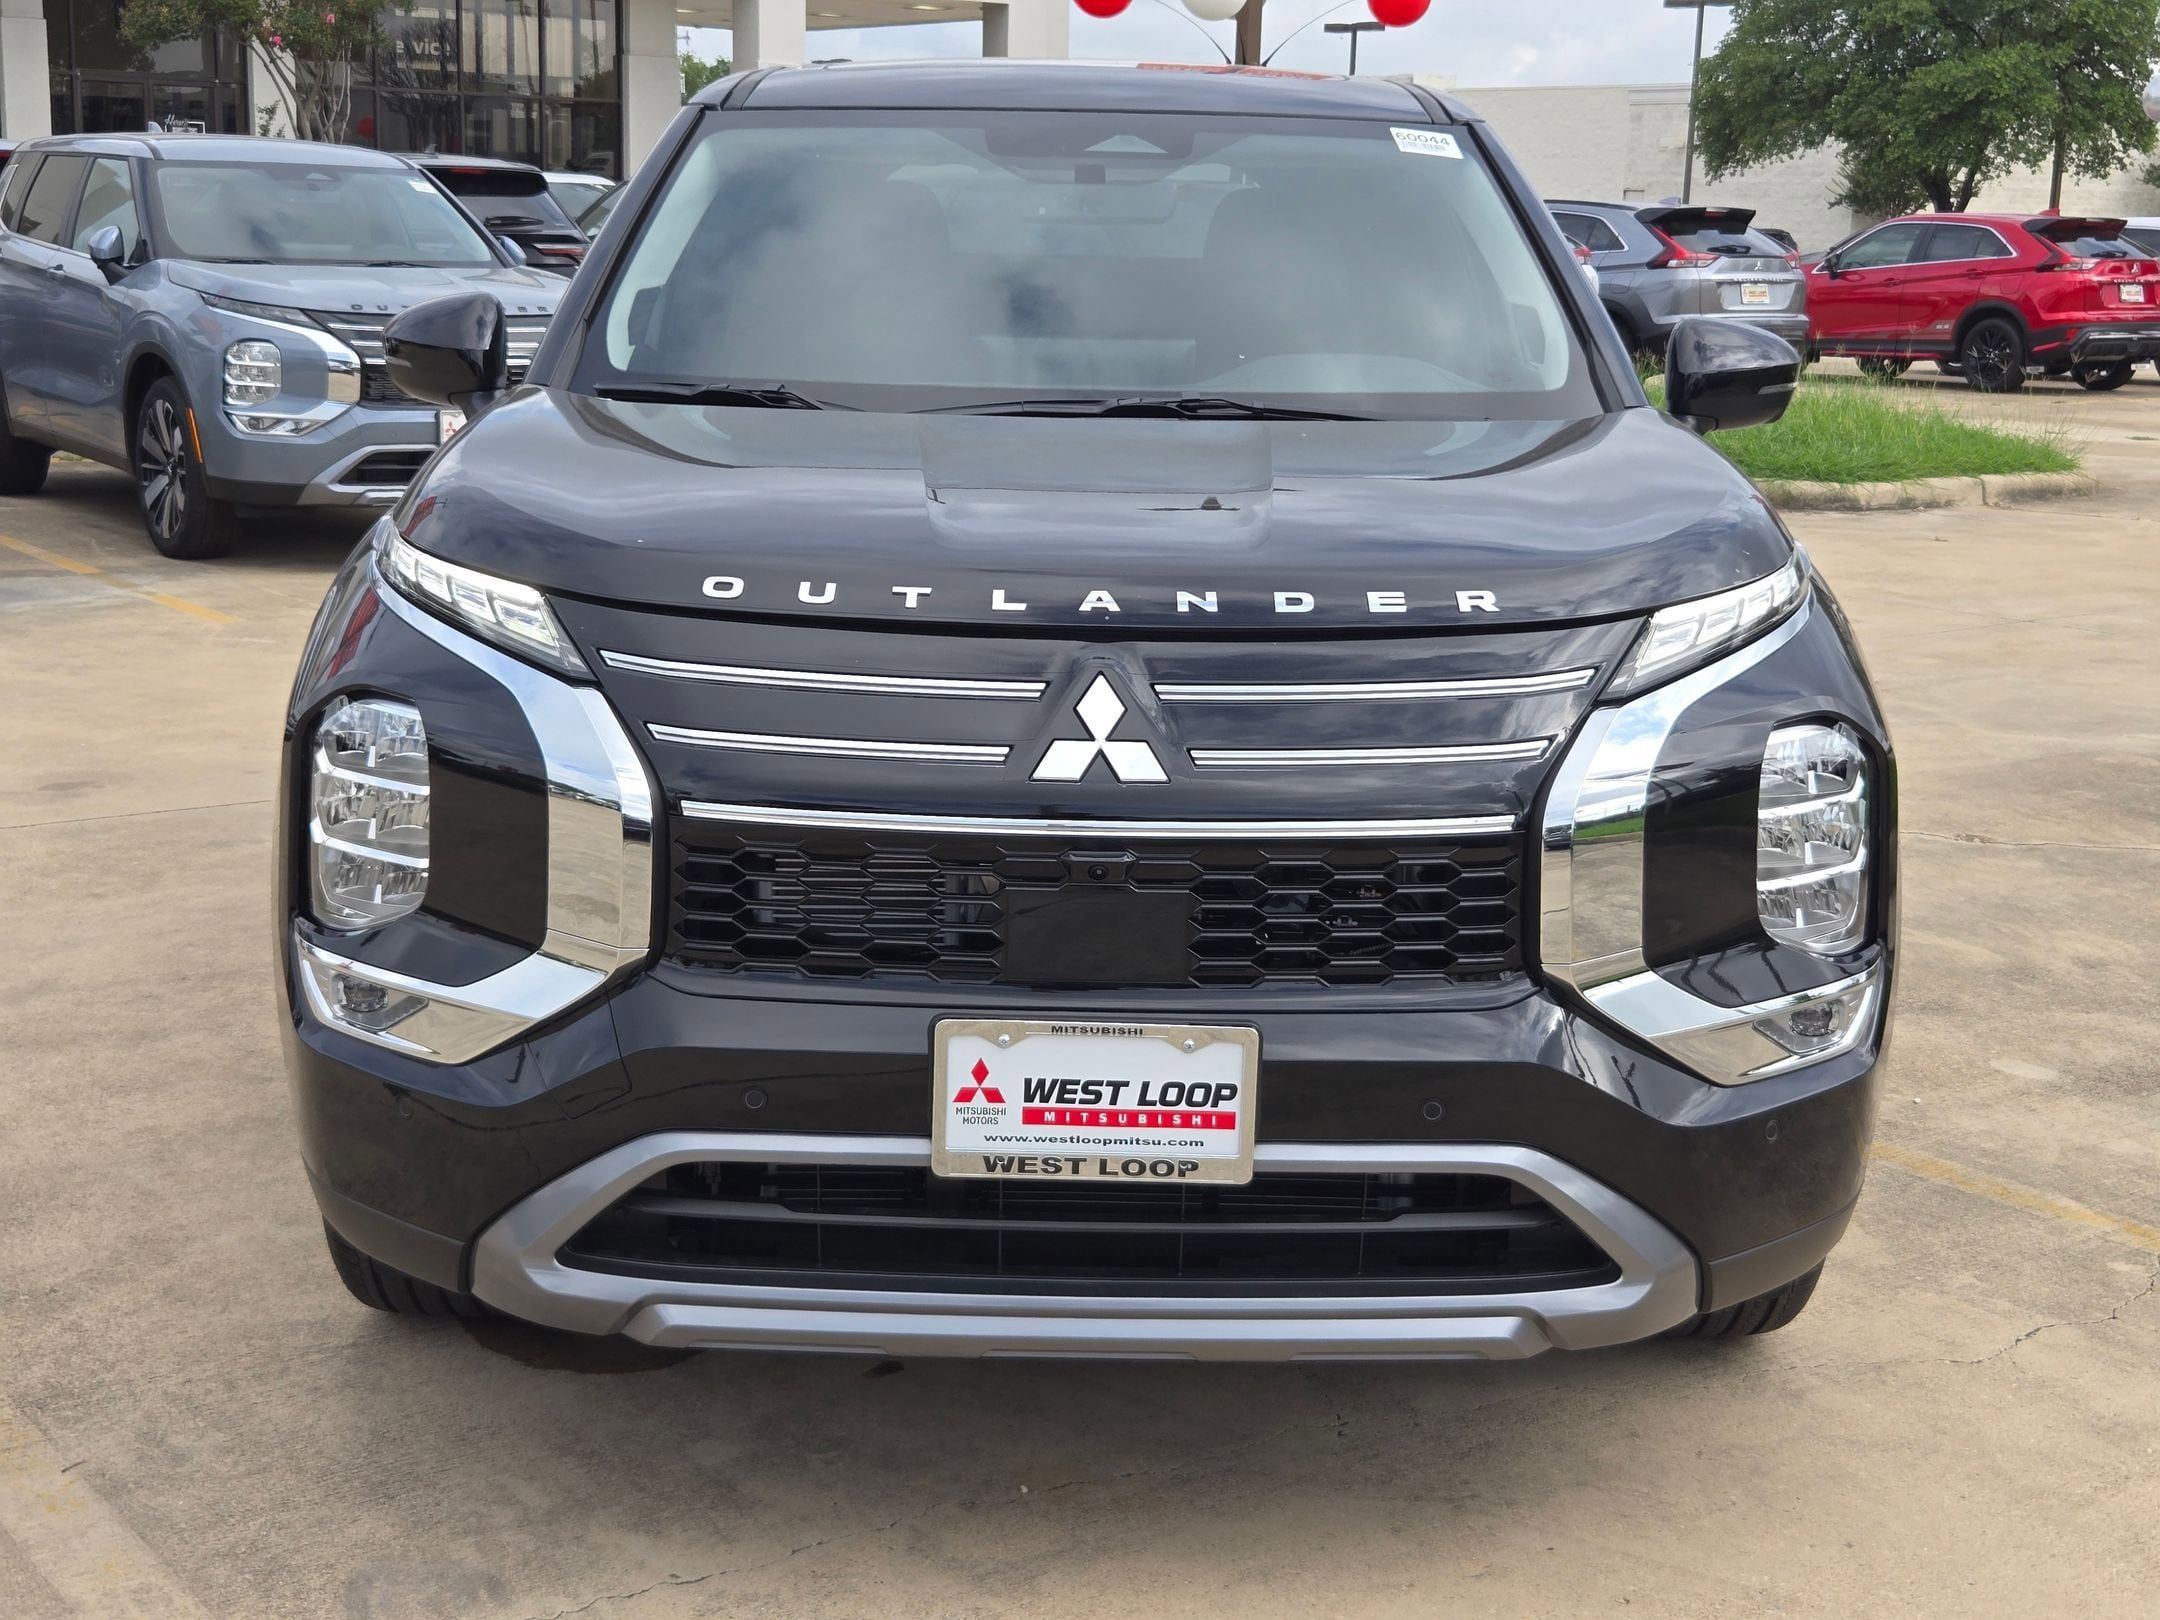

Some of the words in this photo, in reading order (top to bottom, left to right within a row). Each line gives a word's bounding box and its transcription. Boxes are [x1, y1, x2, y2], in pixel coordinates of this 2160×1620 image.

[702, 575, 1501, 613] OUTLANDER
[1051, 1025, 1144, 1036] MITSUBISHI
[1023, 1077, 1130, 1106] WEST
[1136, 1080, 1238, 1108] LOOP
[955, 1106, 1007, 1116] MITSUBISHI
[962, 1116, 999, 1125] MOTORS
[1044, 1111, 1216, 1126] MITSUBISHI
[983, 1134, 1204, 1148] www.westloopmitsu.com
[982, 1155, 1088, 1175] WEST
[1098, 1157, 1200, 1178] LOOP
